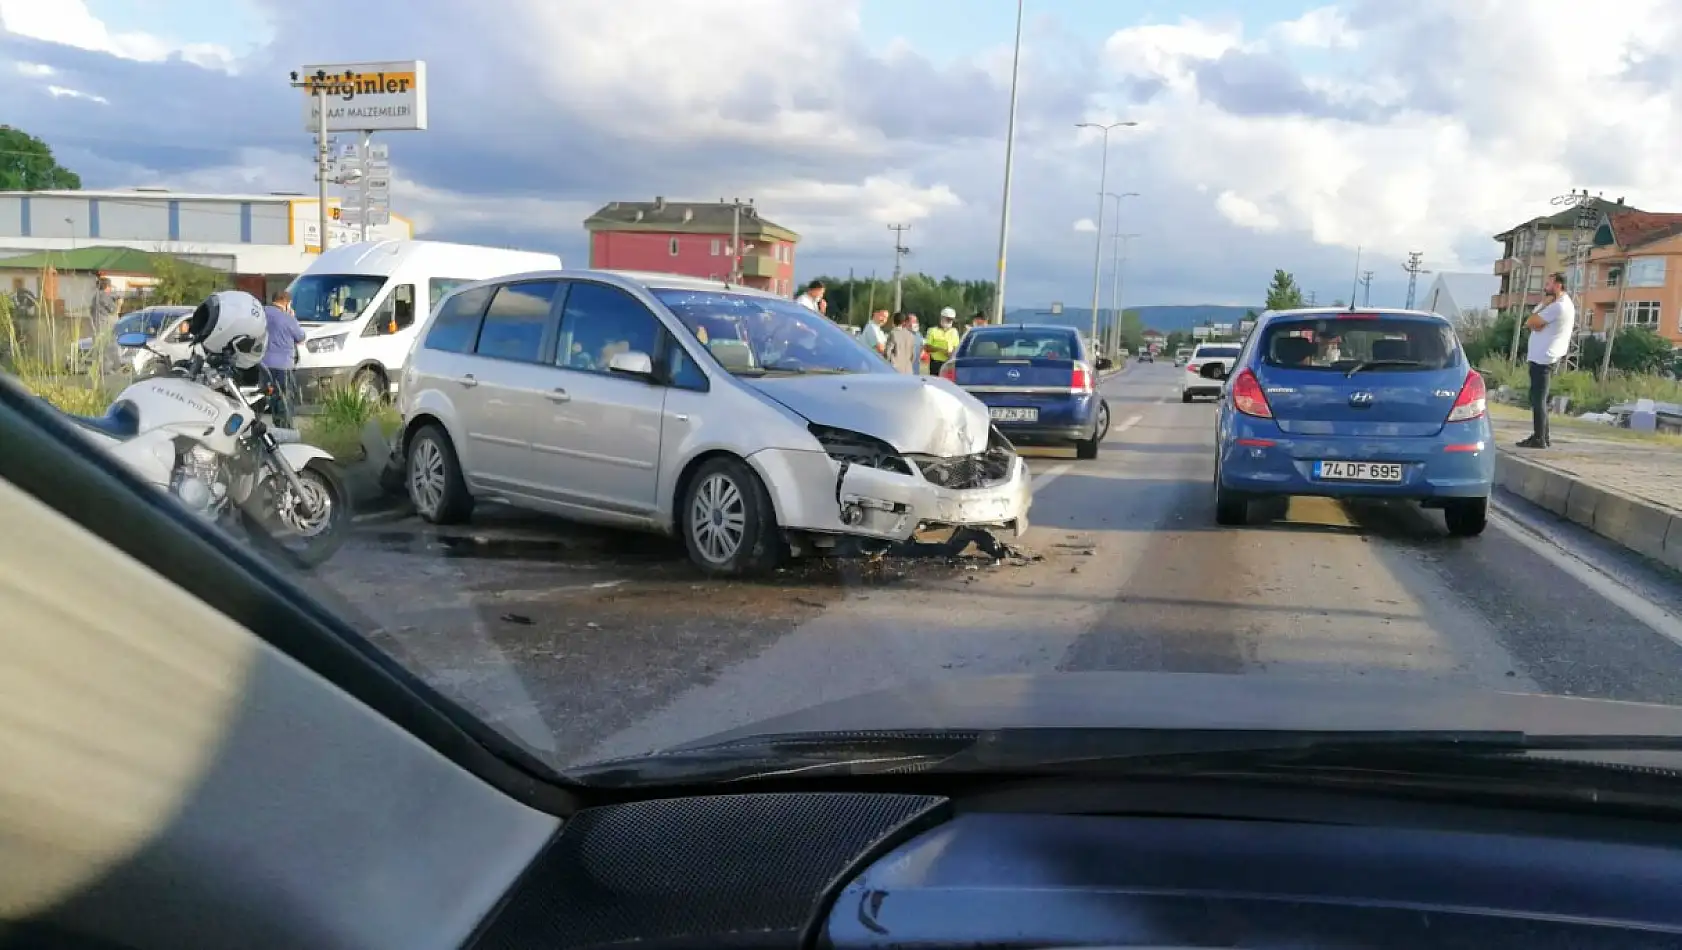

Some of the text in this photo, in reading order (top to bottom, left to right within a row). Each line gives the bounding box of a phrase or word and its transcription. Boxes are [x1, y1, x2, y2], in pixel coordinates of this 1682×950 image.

[311, 106, 345, 118] İNAAT
[1323, 463, 1343, 476] 74
[1346, 464, 1367, 477] DF
[1370, 465, 1400, 479] 695
